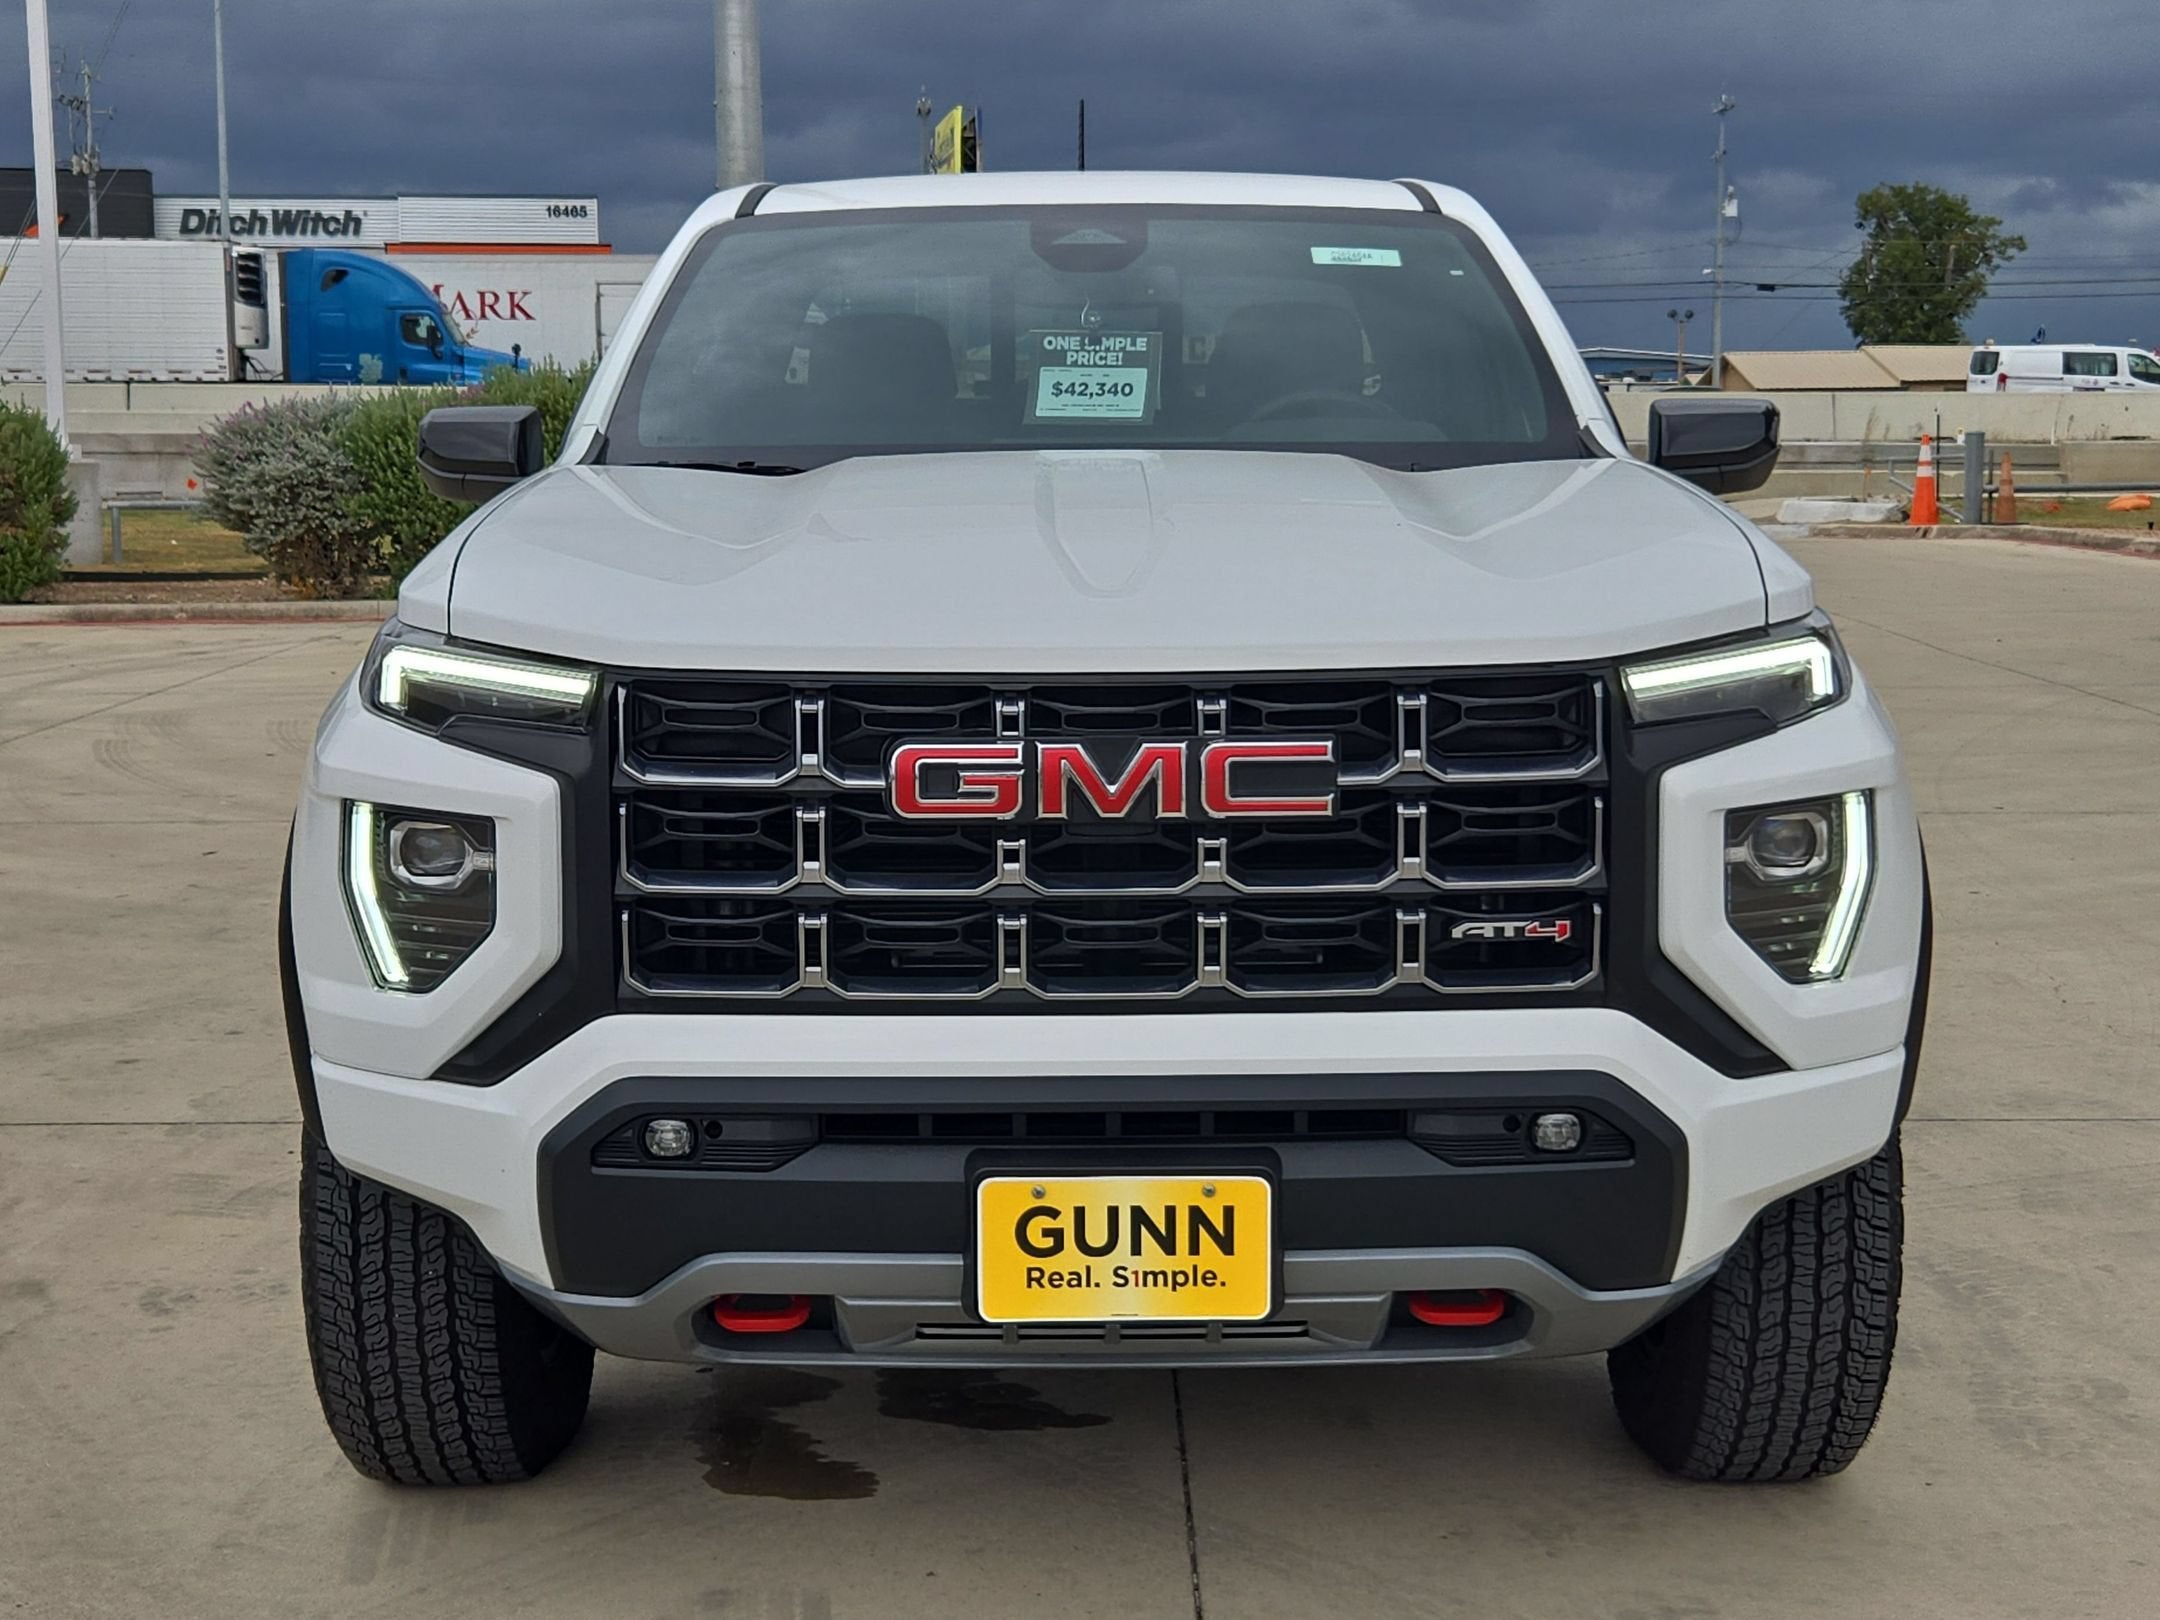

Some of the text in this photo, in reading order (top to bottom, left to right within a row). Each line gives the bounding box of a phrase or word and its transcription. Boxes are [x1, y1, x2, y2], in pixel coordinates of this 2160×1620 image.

[271, 208, 363, 236] Witch
[1043, 336, 1081, 351] ONE
[1066, 352, 1124, 366] PRICE!
[1051, 381, 1134, 399] $42,340
[889, 740, 1337, 820] GMC
[1451, 920, 1571, 942] AT4
[1014, 1205, 1235, 1258] GUNN
[1026, 1265, 1101, 1289] Real.
